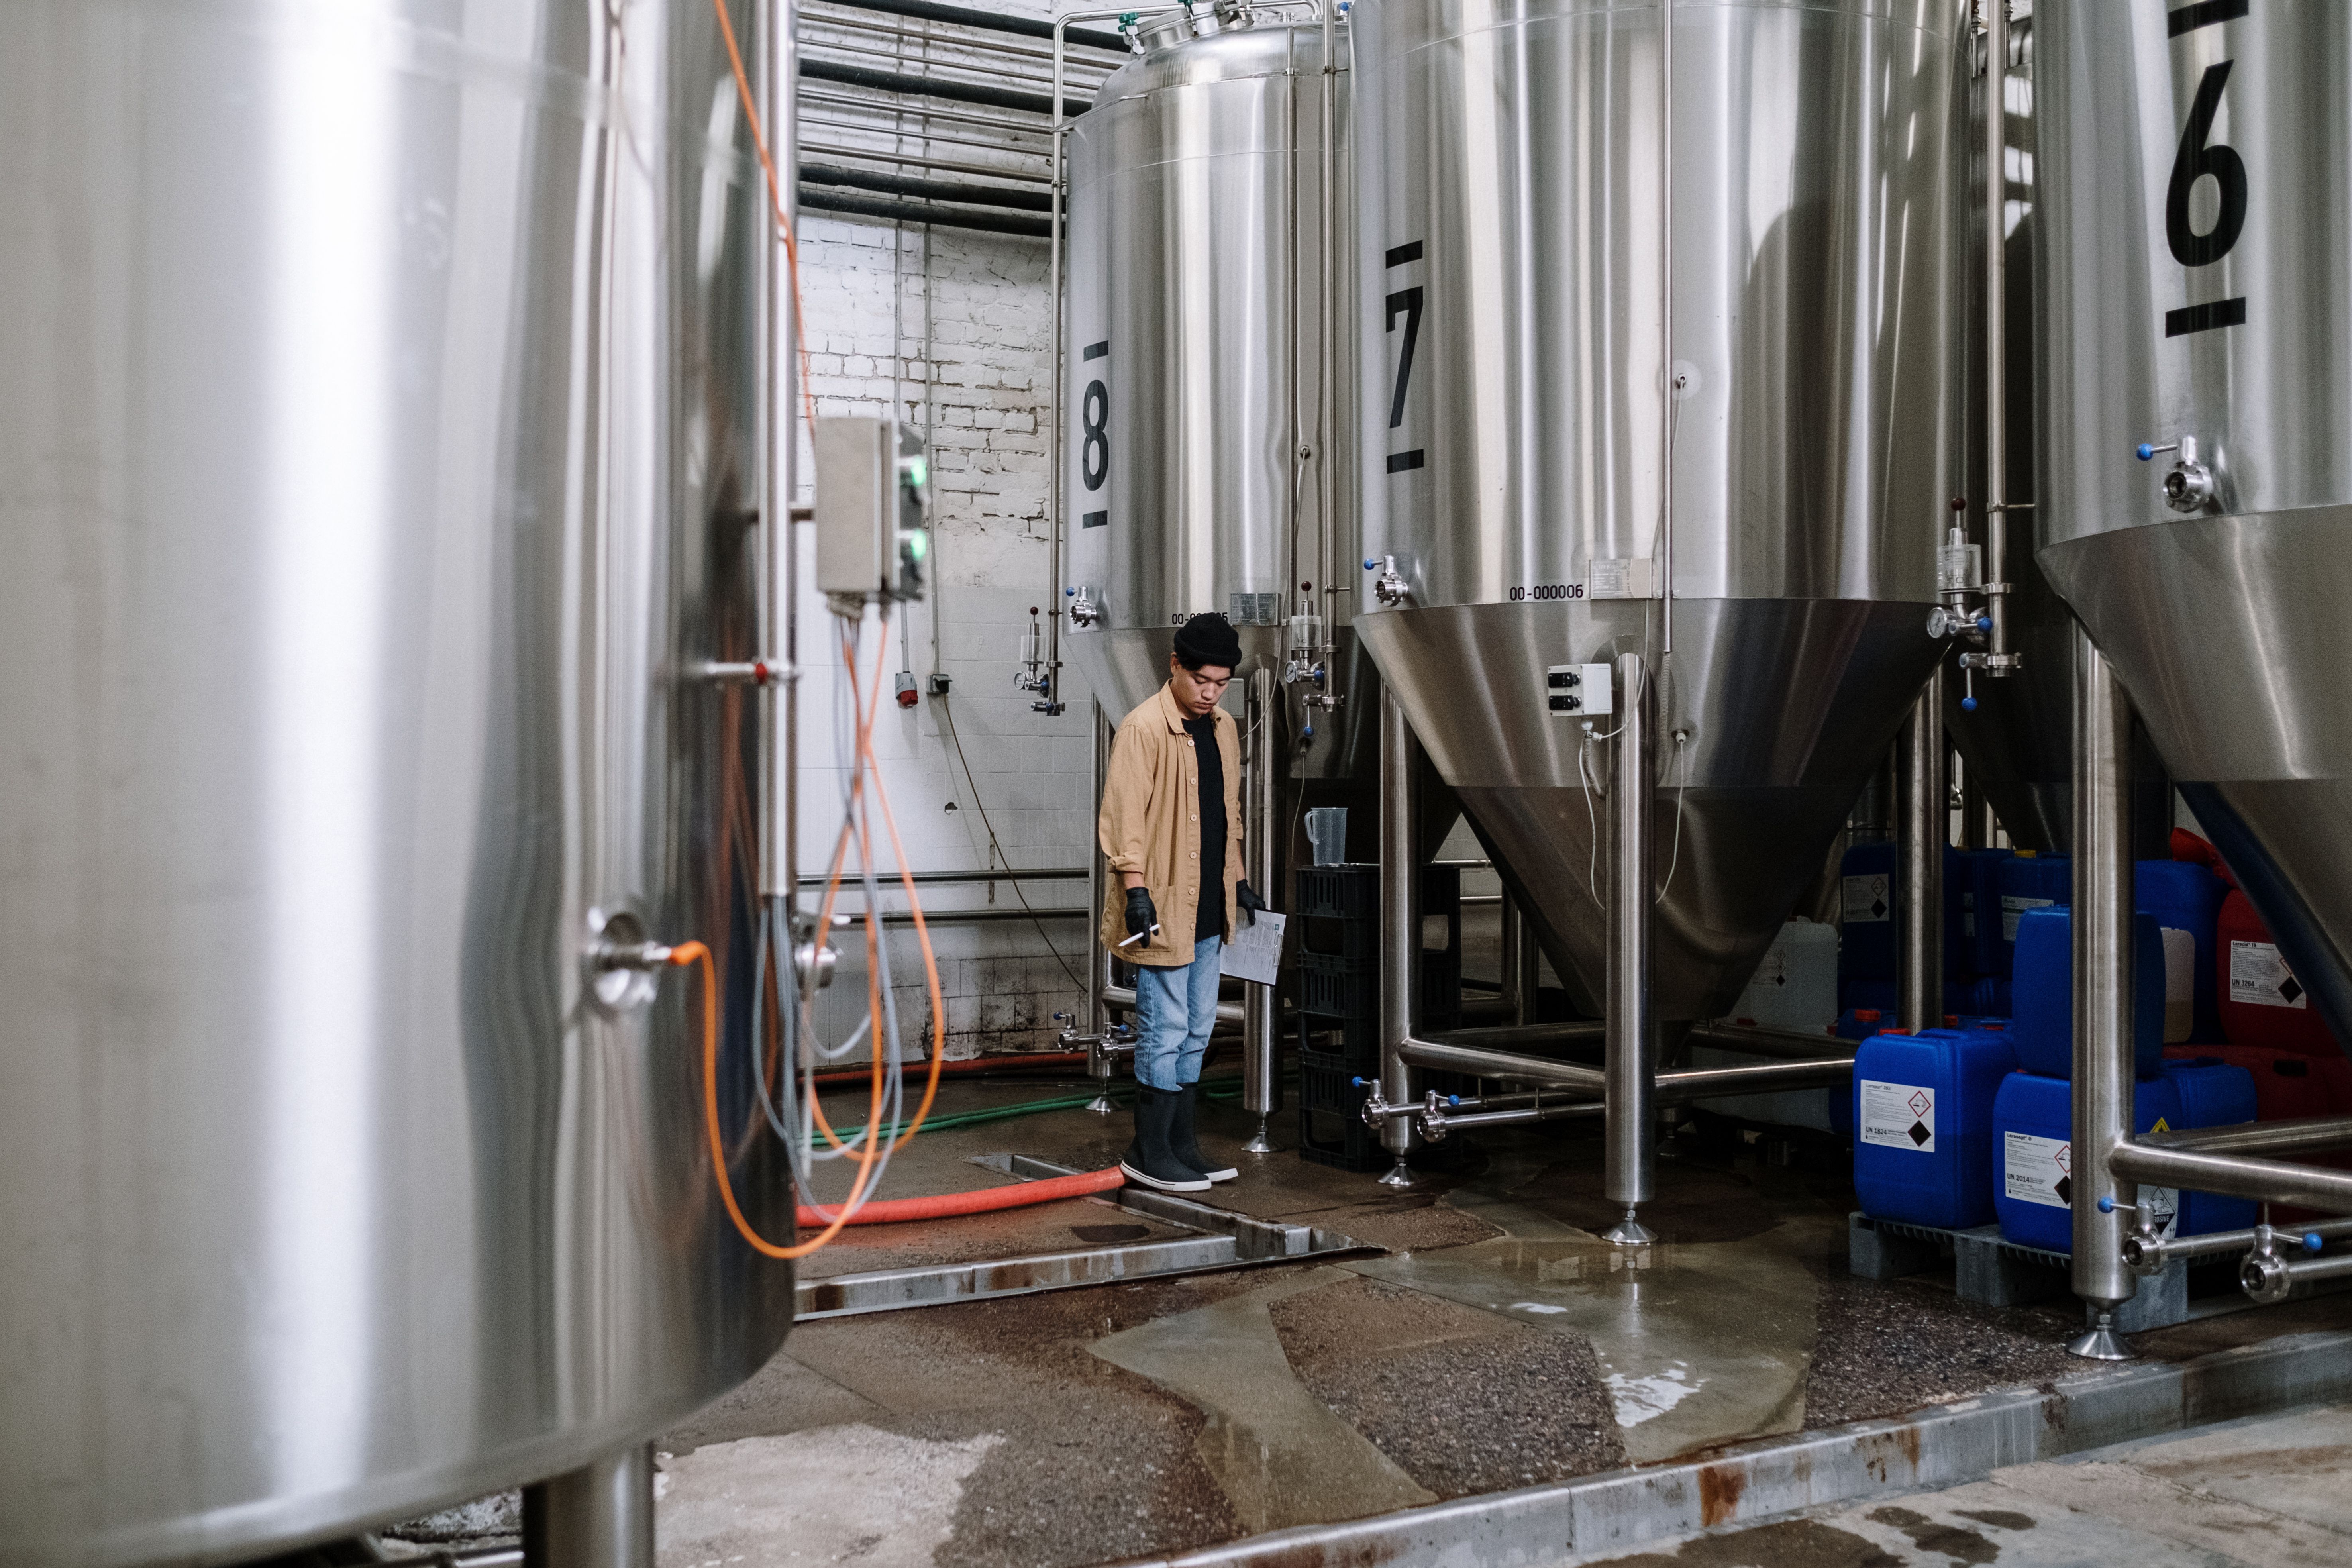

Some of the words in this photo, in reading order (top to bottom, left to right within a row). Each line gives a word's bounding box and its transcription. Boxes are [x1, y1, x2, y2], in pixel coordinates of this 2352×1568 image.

[2166, 59, 2248, 267] 6
[1385, 285, 1424, 429] 7
[1082, 379, 1109, 491] 8
[1509, 584, 1583, 601] 00-000006
